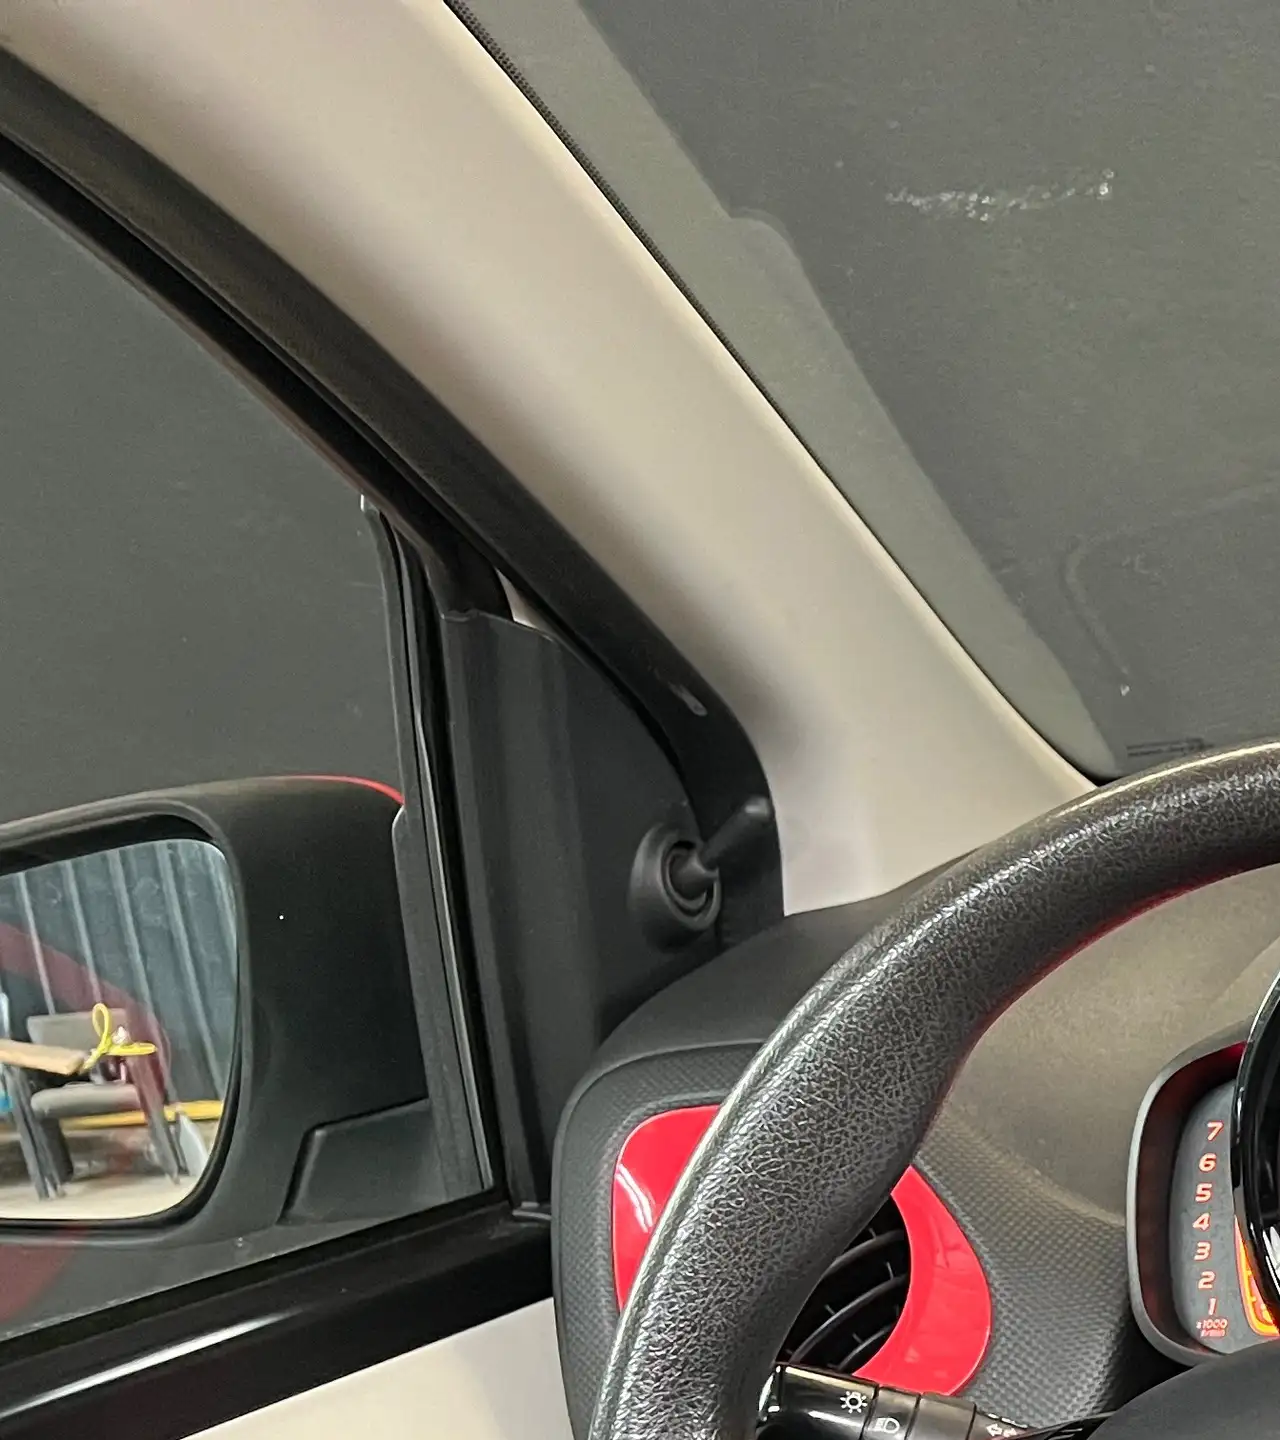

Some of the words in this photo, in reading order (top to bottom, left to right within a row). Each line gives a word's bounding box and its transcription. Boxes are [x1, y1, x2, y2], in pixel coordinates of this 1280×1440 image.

[1207, 1121, 1224, 1142] 7
[1198, 1152, 1217, 1172] 6
[1195, 1183, 1213, 1202] 5
[1192, 1212, 1211, 1231] 4
[1194, 1241, 1212, 1261] 3
[1198, 1270, 1216, 1289] 2
[1207, 1297, 1217, 1316] 1
